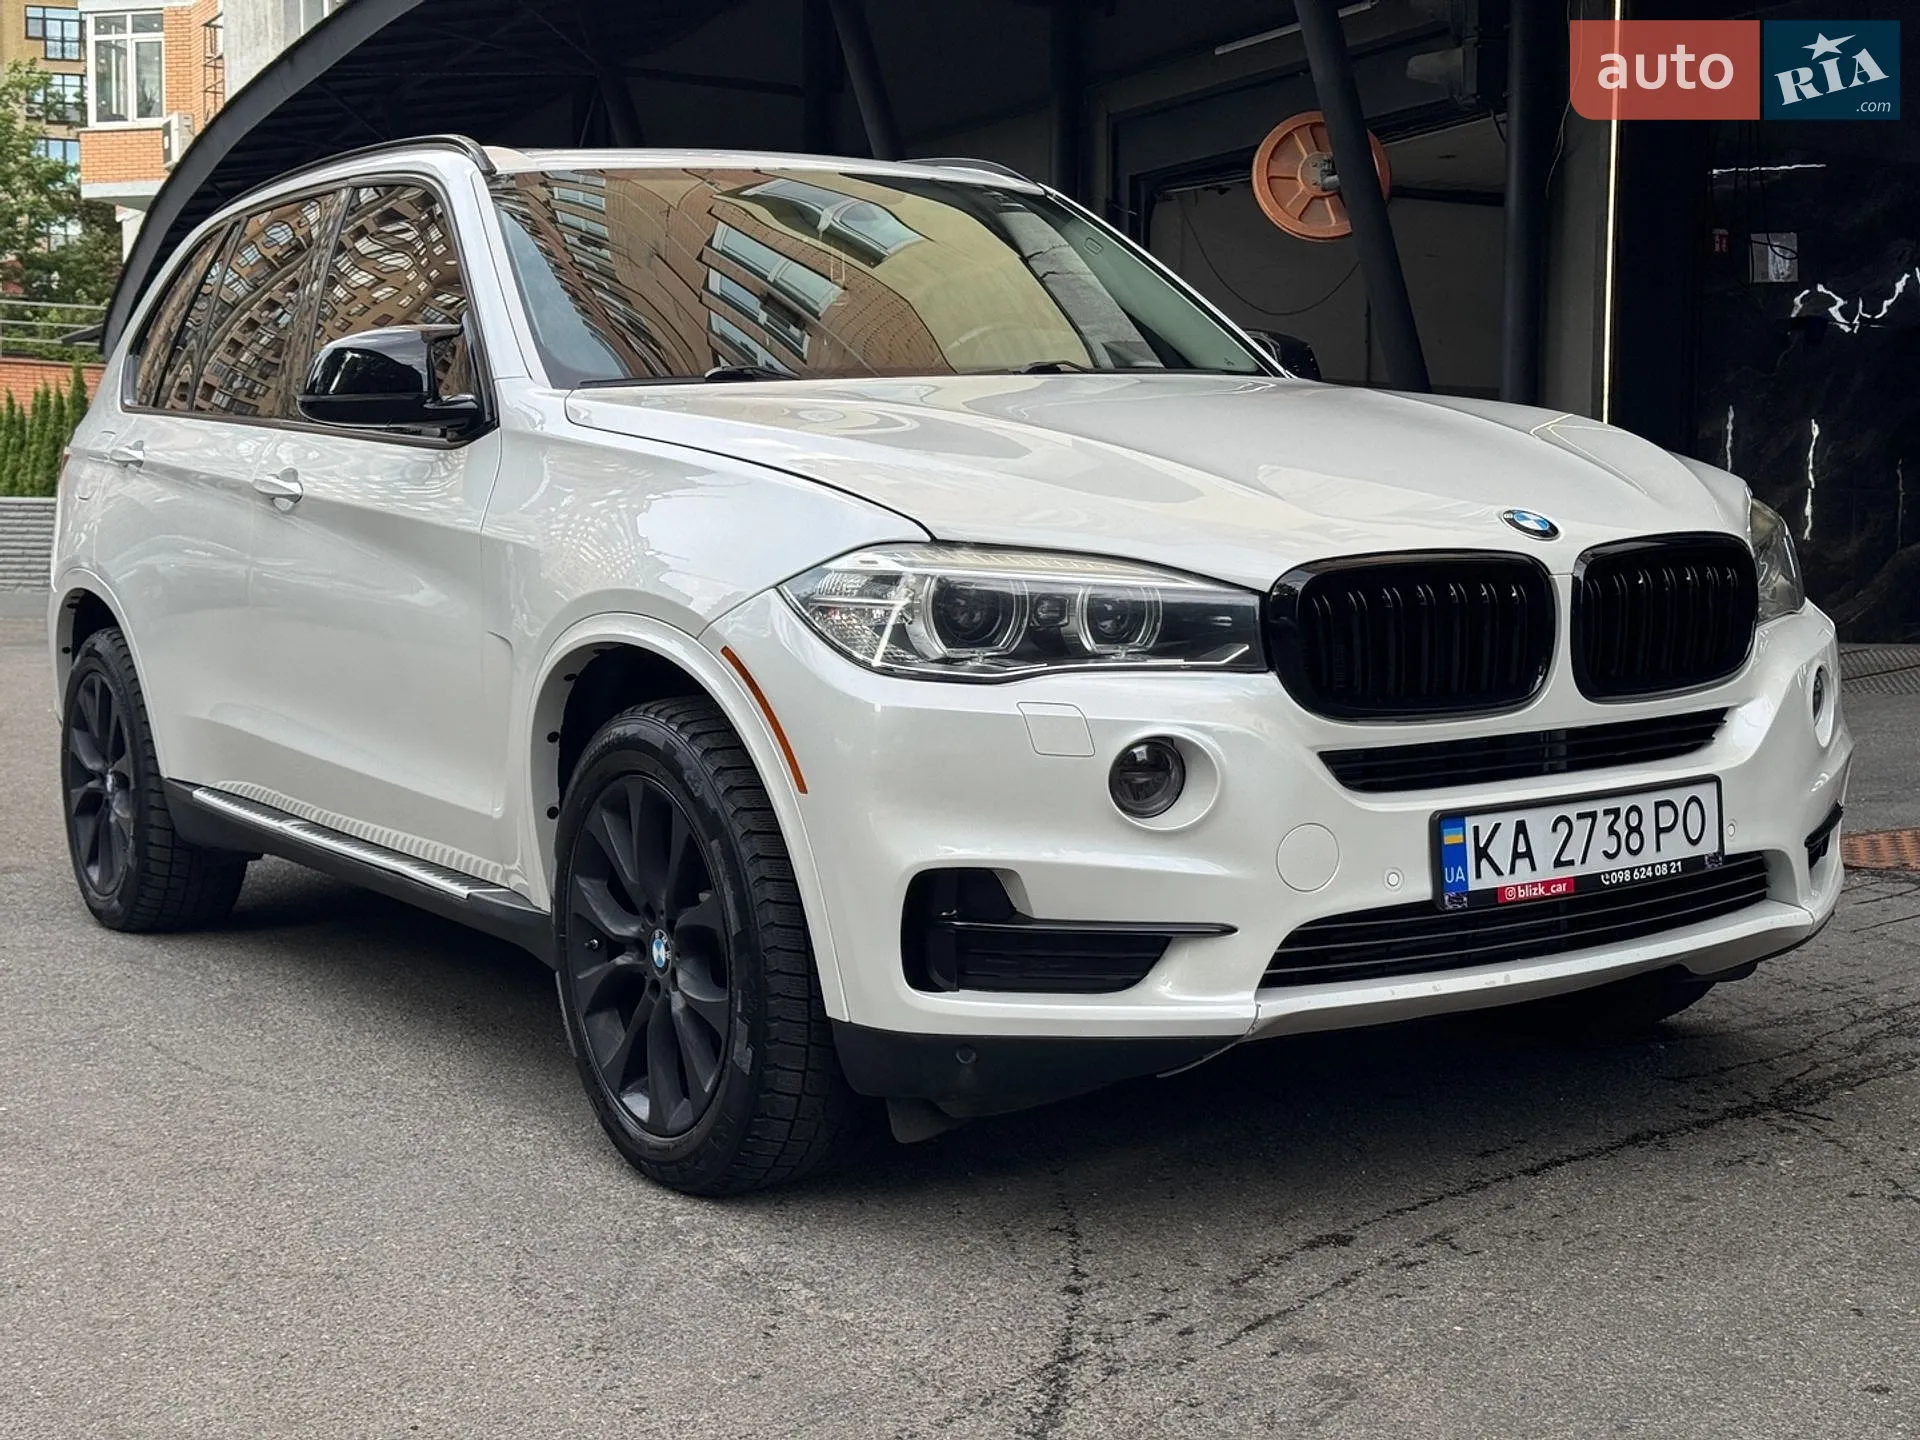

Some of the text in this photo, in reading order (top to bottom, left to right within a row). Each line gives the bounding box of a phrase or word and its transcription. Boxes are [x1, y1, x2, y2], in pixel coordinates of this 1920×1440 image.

[1472, 795, 1706, 880] KA 2738 PO
[1444, 865, 1466, 883] UA
[1611, 861, 1682, 884] 098 624 08 21
